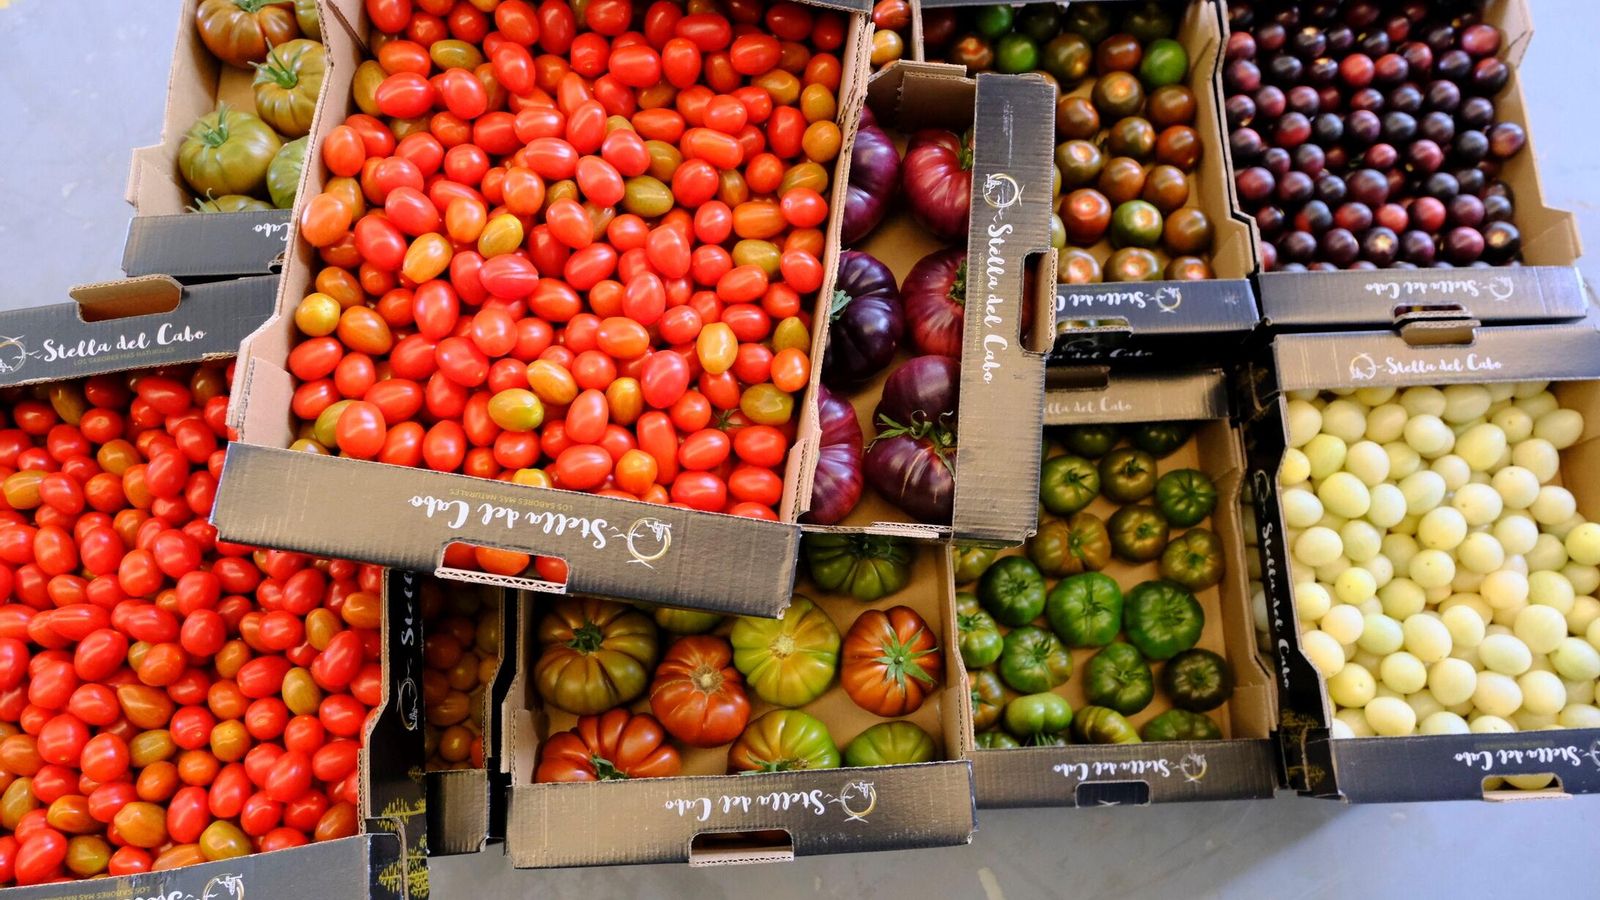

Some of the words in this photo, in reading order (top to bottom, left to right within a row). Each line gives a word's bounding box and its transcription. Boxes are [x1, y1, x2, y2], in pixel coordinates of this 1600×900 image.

[986, 223, 1014, 291] Stella
[1365, 282, 1400, 299] Cabo
[1403, 280, 1428, 294] del
[1429, 279, 1479, 297] Stella
[1069, 293, 1094, 307] del
[1096, 291, 1146, 309] Stella
[984, 293, 1004, 329] del
[43, 338, 112, 362] Stella
[116, 332, 151, 350] del
[157, 322, 207, 346] Cabo
[982, 334, 1008, 385] Cabo
[1386, 356, 1437, 375] Stella
[1439, 358, 1464, 372] del
[1466, 353, 1502, 371] Cabo
[450, 488, 498, 502] NATURALES
[519, 497, 556, 510] SABORES
[407, 495, 470, 529] Cabo
[477, 503, 520, 529] del
[557, 503, 573, 512] LOS
[525, 511, 608, 549] Stella
[1453, 750, 1493, 771] Cabo
[1496, 749, 1524, 765] del
[1525, 745, 1581, 767] Stella
[1053, 762, 1089, 781] Cabo
[1092, 761, 1117, 776] del
[1120, 758, 1170, 778] Stella
[664, 797, 712, 822] Cabo
[718, 795, 751, 813] del
[756, 789, 825, 816] Stella
